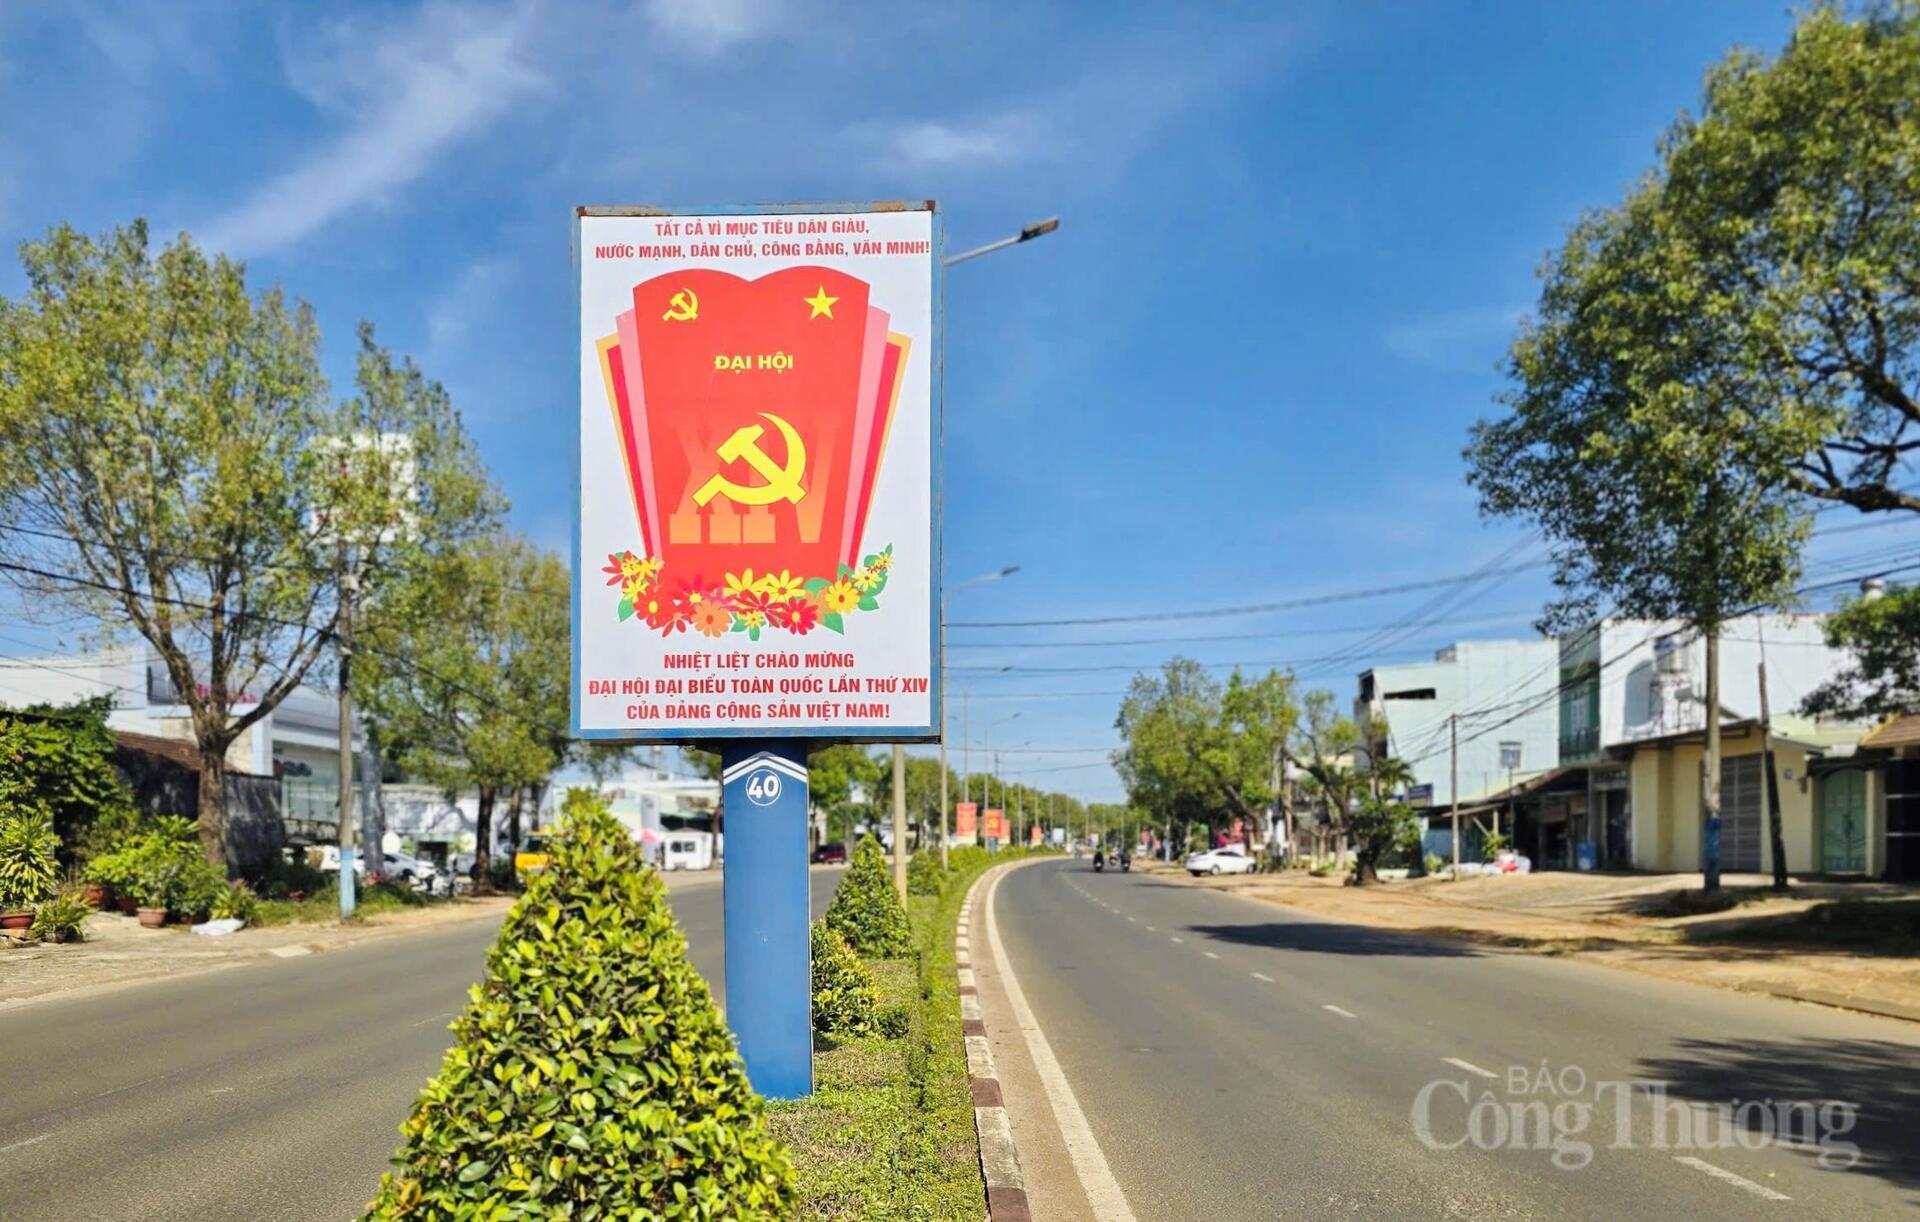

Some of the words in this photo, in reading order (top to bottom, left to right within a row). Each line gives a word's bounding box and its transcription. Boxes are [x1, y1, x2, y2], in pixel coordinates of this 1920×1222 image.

[656, 219, 680, 236] TẤT
[685, 219, 704, 235] CẢ
[708, 220, 721, 235] VÌ
[726, 222, 758, 238] MỤC
[762, 219, 793, 235] TIÊU
[798, 219, 828, 234] DÂN
[831, 218, 869, 234] GIÀU,
[595, 243, 634, 259] NƯỚC
[639, 245, 686, 261] MẠNH,
[690, 242, 721, 258] DÂN
[724, 240, 757, 258] CHỦ,
[761, 241, 801, 257] CÔNG
[805, 238, 849, 257] BẰNG,
[853, 240, 883, 256] VĂN
[886, 241, 931, 255] MINH!
[714, 355, 752, 374] ĐẠI
[758, 352, 794, 374] HỘI
[663, 651, 712, 672] NHIỆT
[716, 651, 750, 672] LIỆT
[755, 651, 800, 669] CHÀO
[804, 651, 855, 669] MỪNG
[588, 679, 617, 698] ĐẠI
[622, 677, 650, 698] HỘI
[654, 679, 683, 697] ĐẠI
[688, 673, 726, 694] BIỂU
[730, 676, 775, 694] TOÀN
[779, 673, 824, 695] QUỐC
[829, 673, 861, 694] LẦN
[866, 675, 898, 694] THỨ
[901, 677, 928, 693] XIV
[626, 700, 661, 720] CỦA
[664, 700, 711, 720] ĐẢNG
[716, 701, 762, 722] CỘNG
[767, 699, 801, 720] SẢN
[806, 701, 840, 722] VIỆT
[845, 703, 890, 719] NAM!
[748, 775, 780, 799] 40
